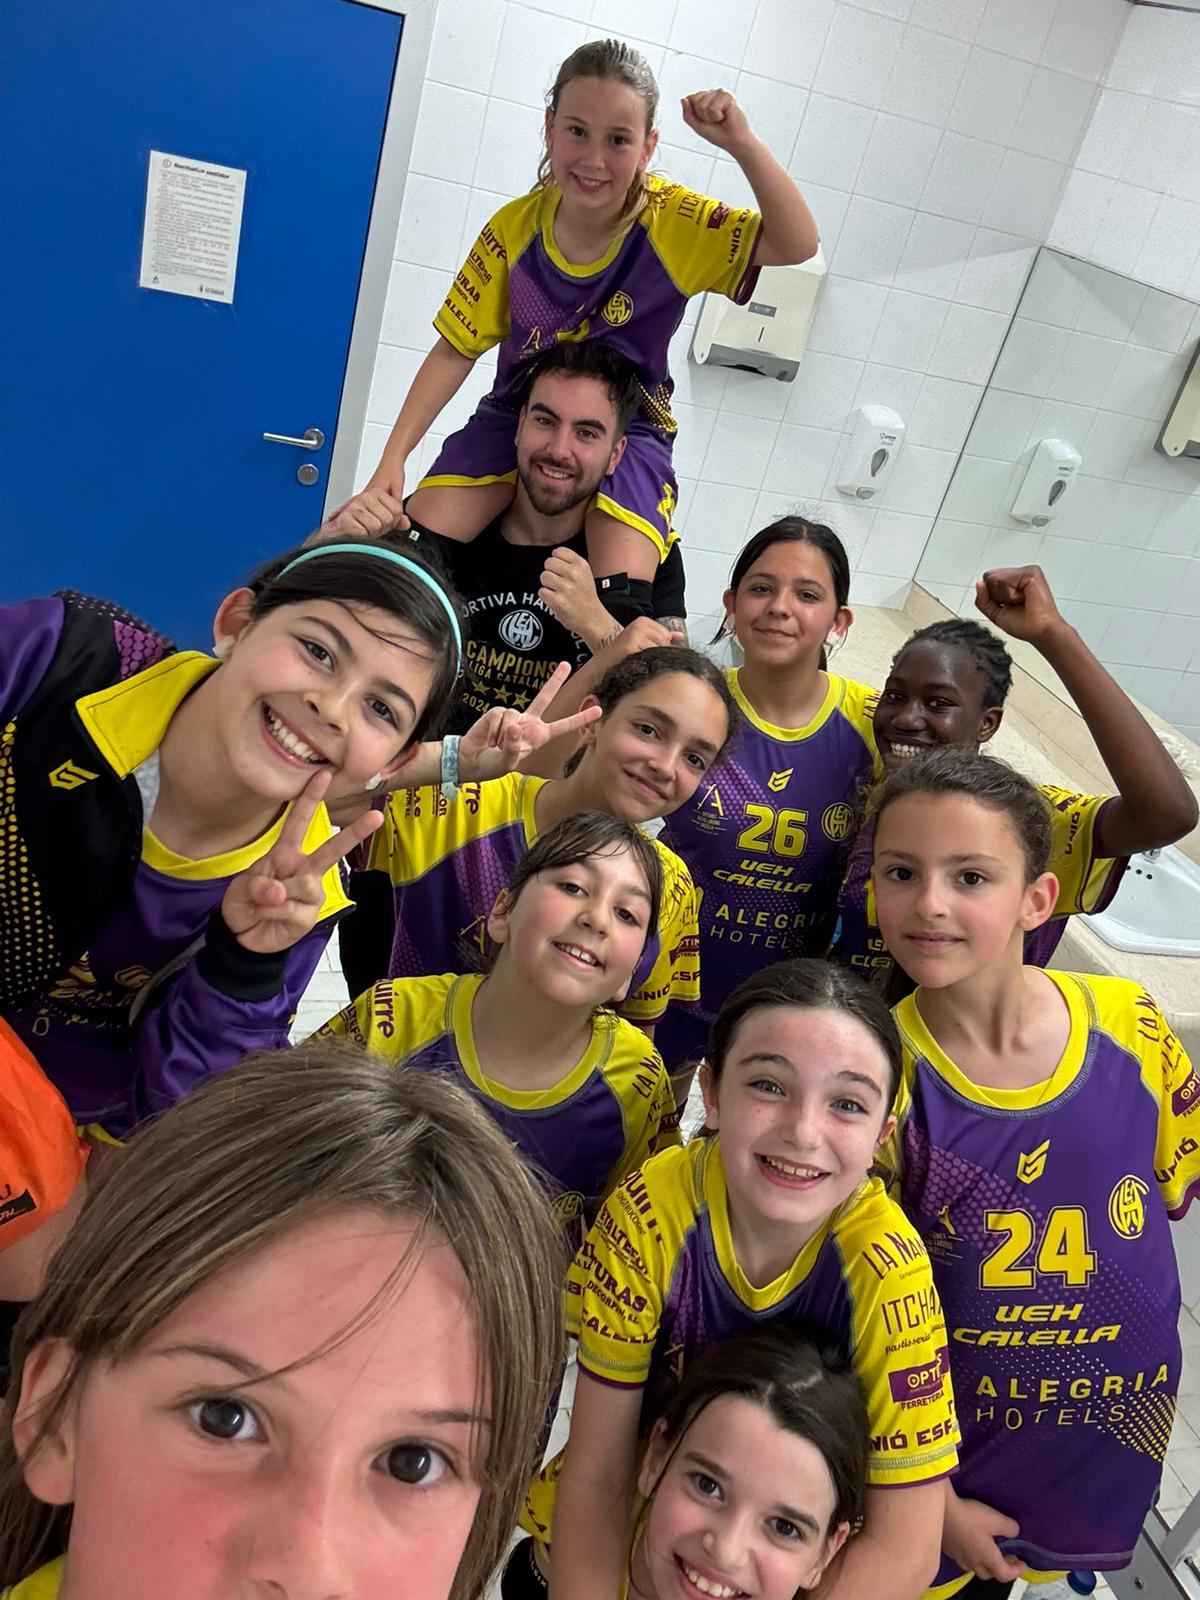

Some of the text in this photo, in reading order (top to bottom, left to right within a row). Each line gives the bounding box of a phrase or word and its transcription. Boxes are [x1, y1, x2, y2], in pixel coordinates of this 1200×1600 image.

[736, 802, 809, 858] 26
[712, 868, 813, 893] CALELLA
[740, 859, 795, 877] UEH
[978, 1205, 1097, 1289] 24
[994, 1303, 1084, 1323] UEH
[952, 1324, 1122, 1347] CALELLA
[976, 1364, 1169, 1402] ALEGRIA
[976, 1404, 1127, 1431] HOTELS
